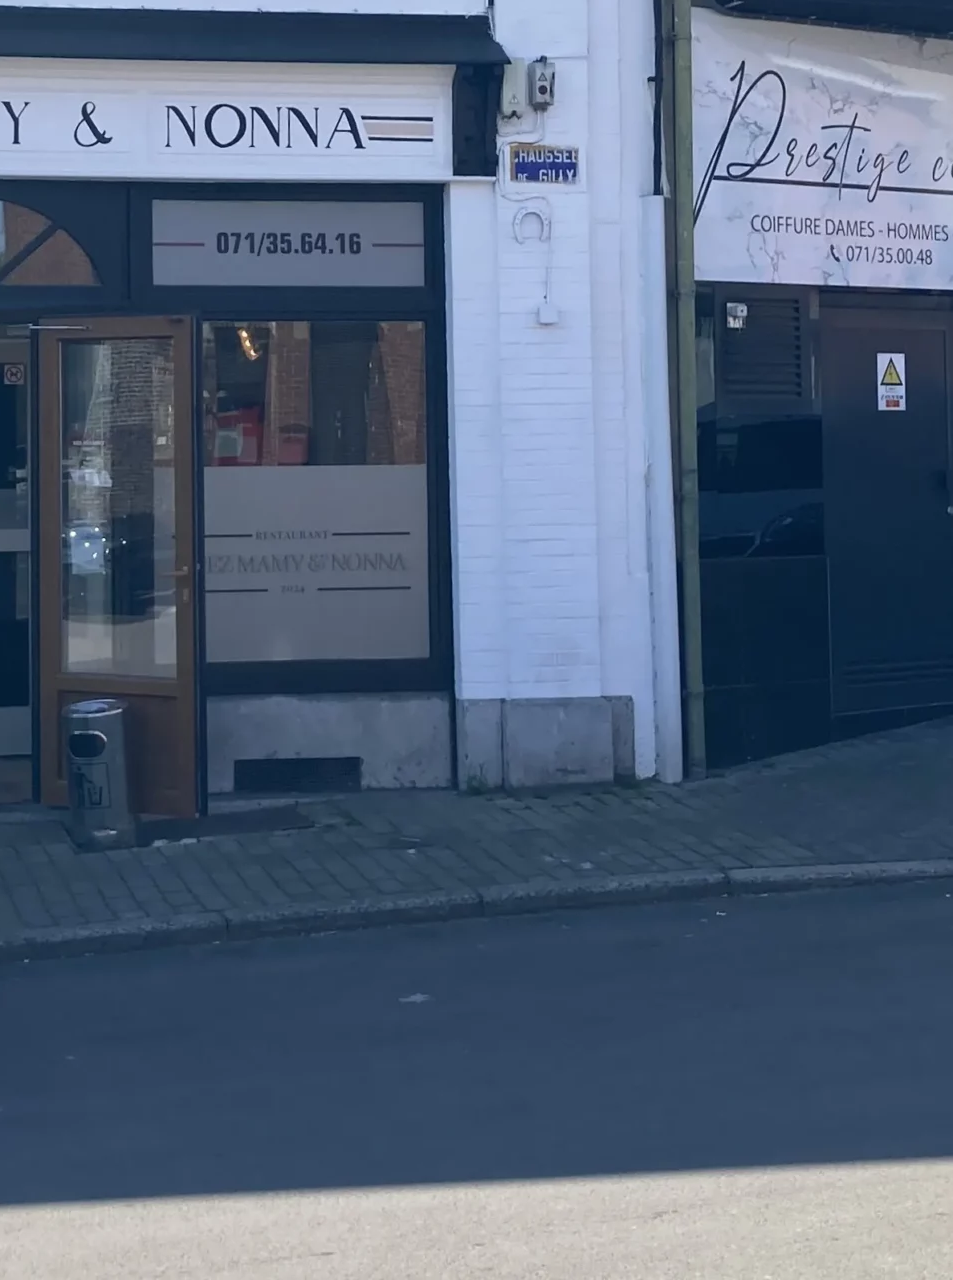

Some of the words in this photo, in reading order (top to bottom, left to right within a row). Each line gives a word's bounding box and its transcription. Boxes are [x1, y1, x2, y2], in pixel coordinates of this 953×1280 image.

[74, 101, 113, 148] &
[164, 103, 366, 150] NONNA
[693, 60, 911, 227] Prestige
[750, 214, 821, 236] COIFFURE
[825, 219, 875, 238] DAMES
[887, 222, 949, 242] HOMMES
[216, 231, 362, 255] 071/35.64.16
[846, 245, 933, 265] 071/35.00.48
[255, 530, 329, 540] RESTAURANT
[237, 554, 305, 573] MAMY
[331, 552, 407, 572] NONNA
